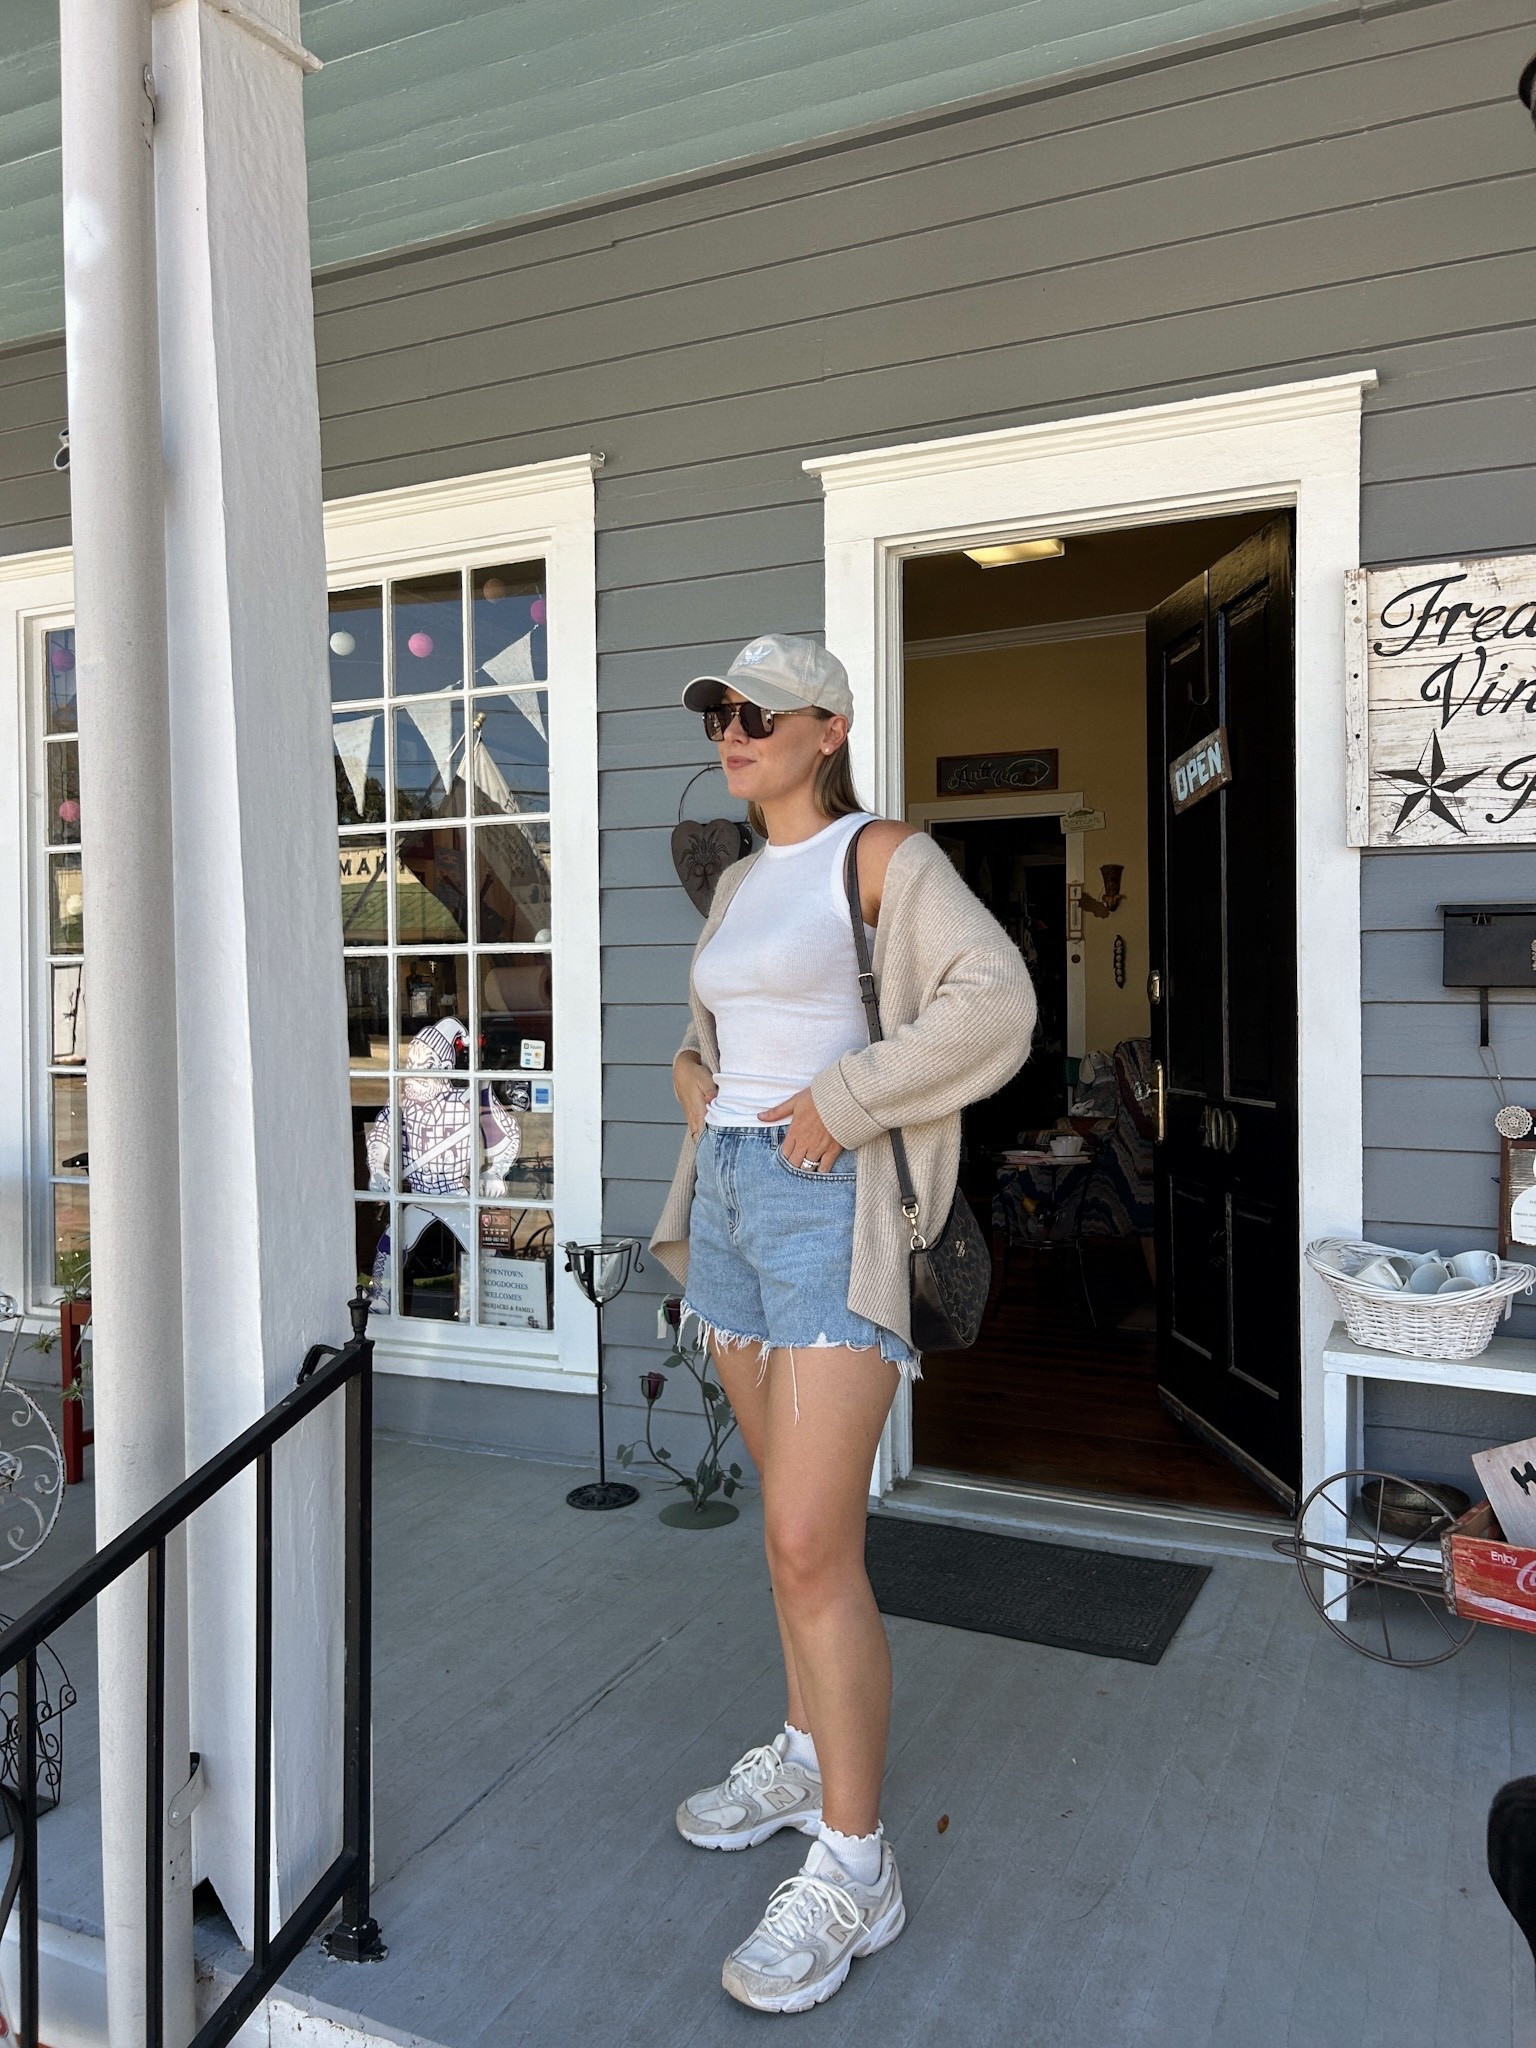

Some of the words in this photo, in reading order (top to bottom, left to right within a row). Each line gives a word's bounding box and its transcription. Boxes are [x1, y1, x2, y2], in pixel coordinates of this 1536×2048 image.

[1174, 741, 1222, 801] OPEN
[482, 1267, 524, 1278] DOWNTOWN
[482, 1279, 529, 1290] ACOGDOCHES
[484, 1291, 523, 1301] WELCOMES
[1490, 1550, 1518, 1567] Enjoy
[763, 1786, 797, 1811] N
